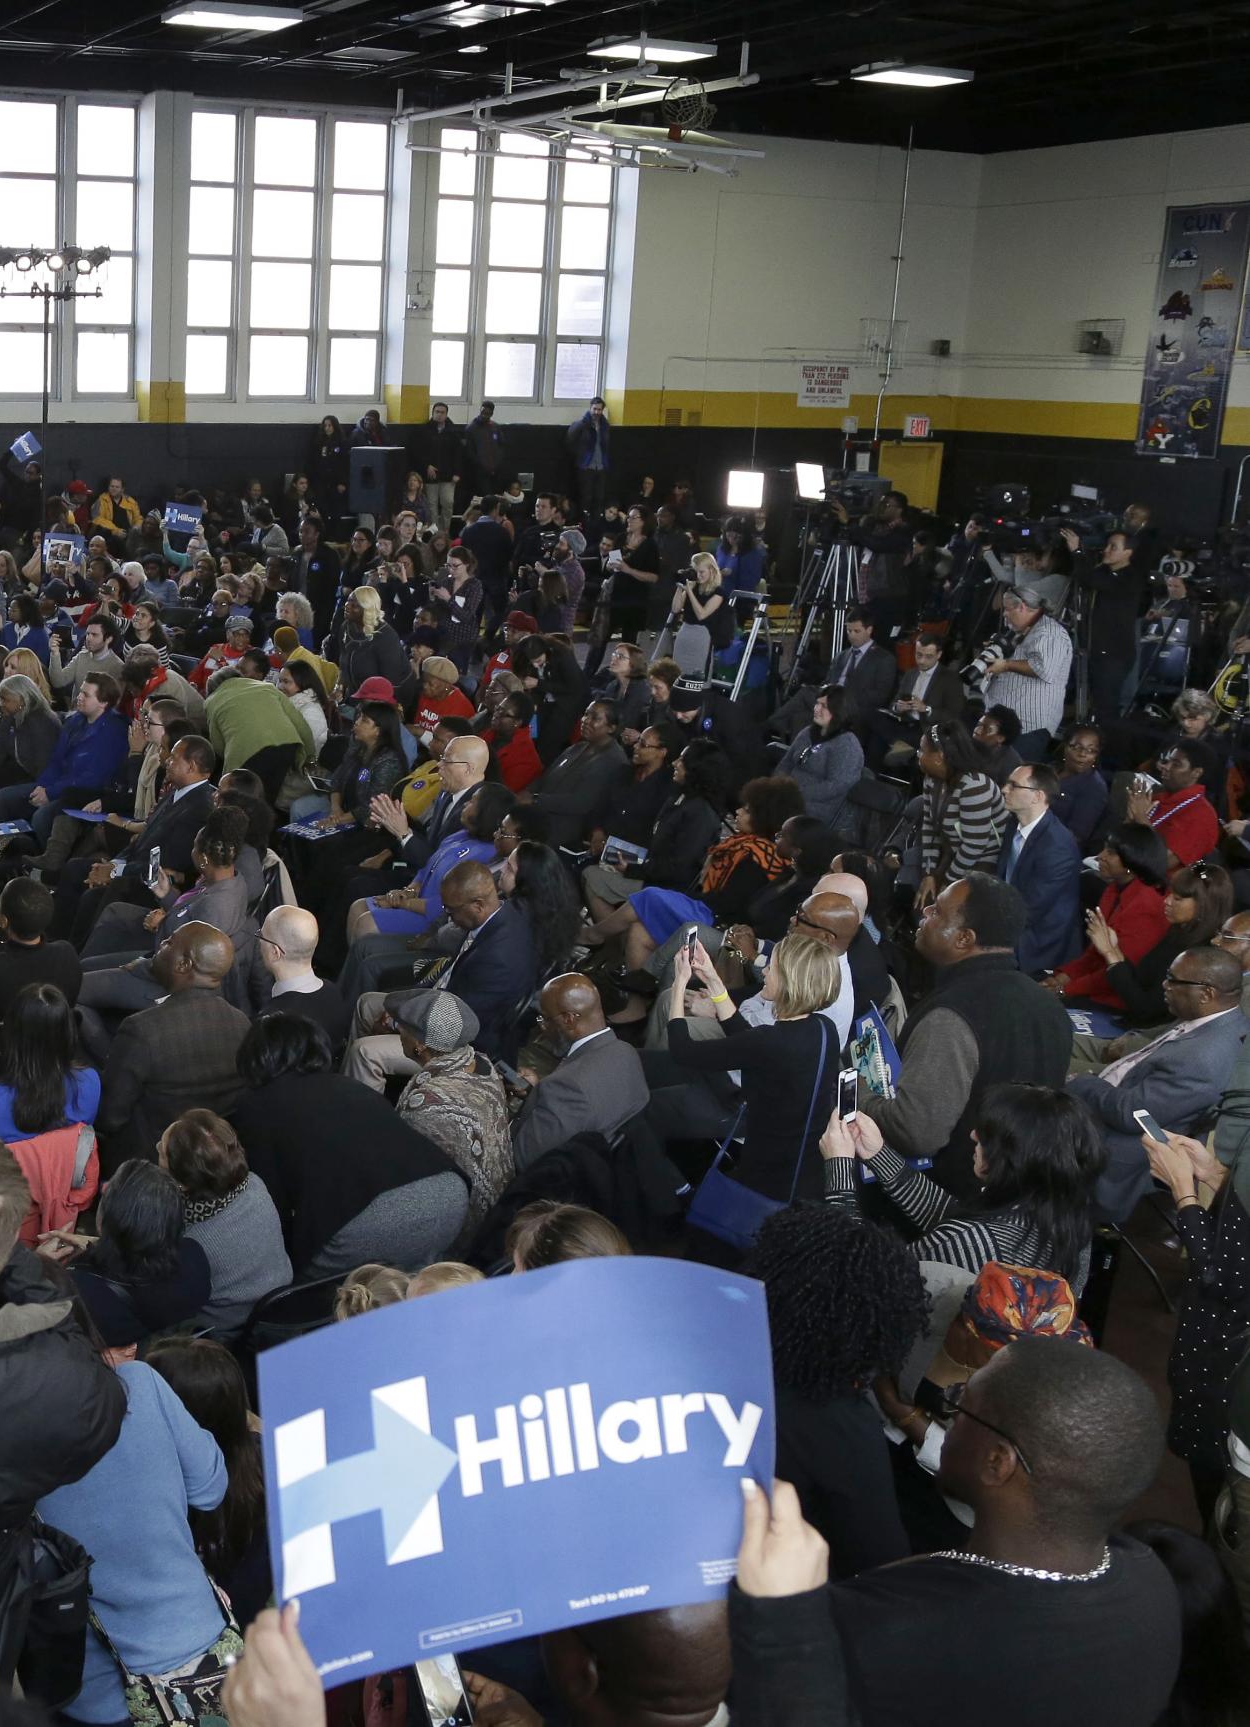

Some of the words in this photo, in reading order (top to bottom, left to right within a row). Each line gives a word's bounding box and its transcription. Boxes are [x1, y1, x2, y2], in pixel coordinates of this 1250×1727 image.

[1183, 212, 1237, 232] CUNY
[910, 419, 927, 436] EXIT
[177, 513, 200, 524] Hillary
[453, 1382, 763, 1498] Hillary
